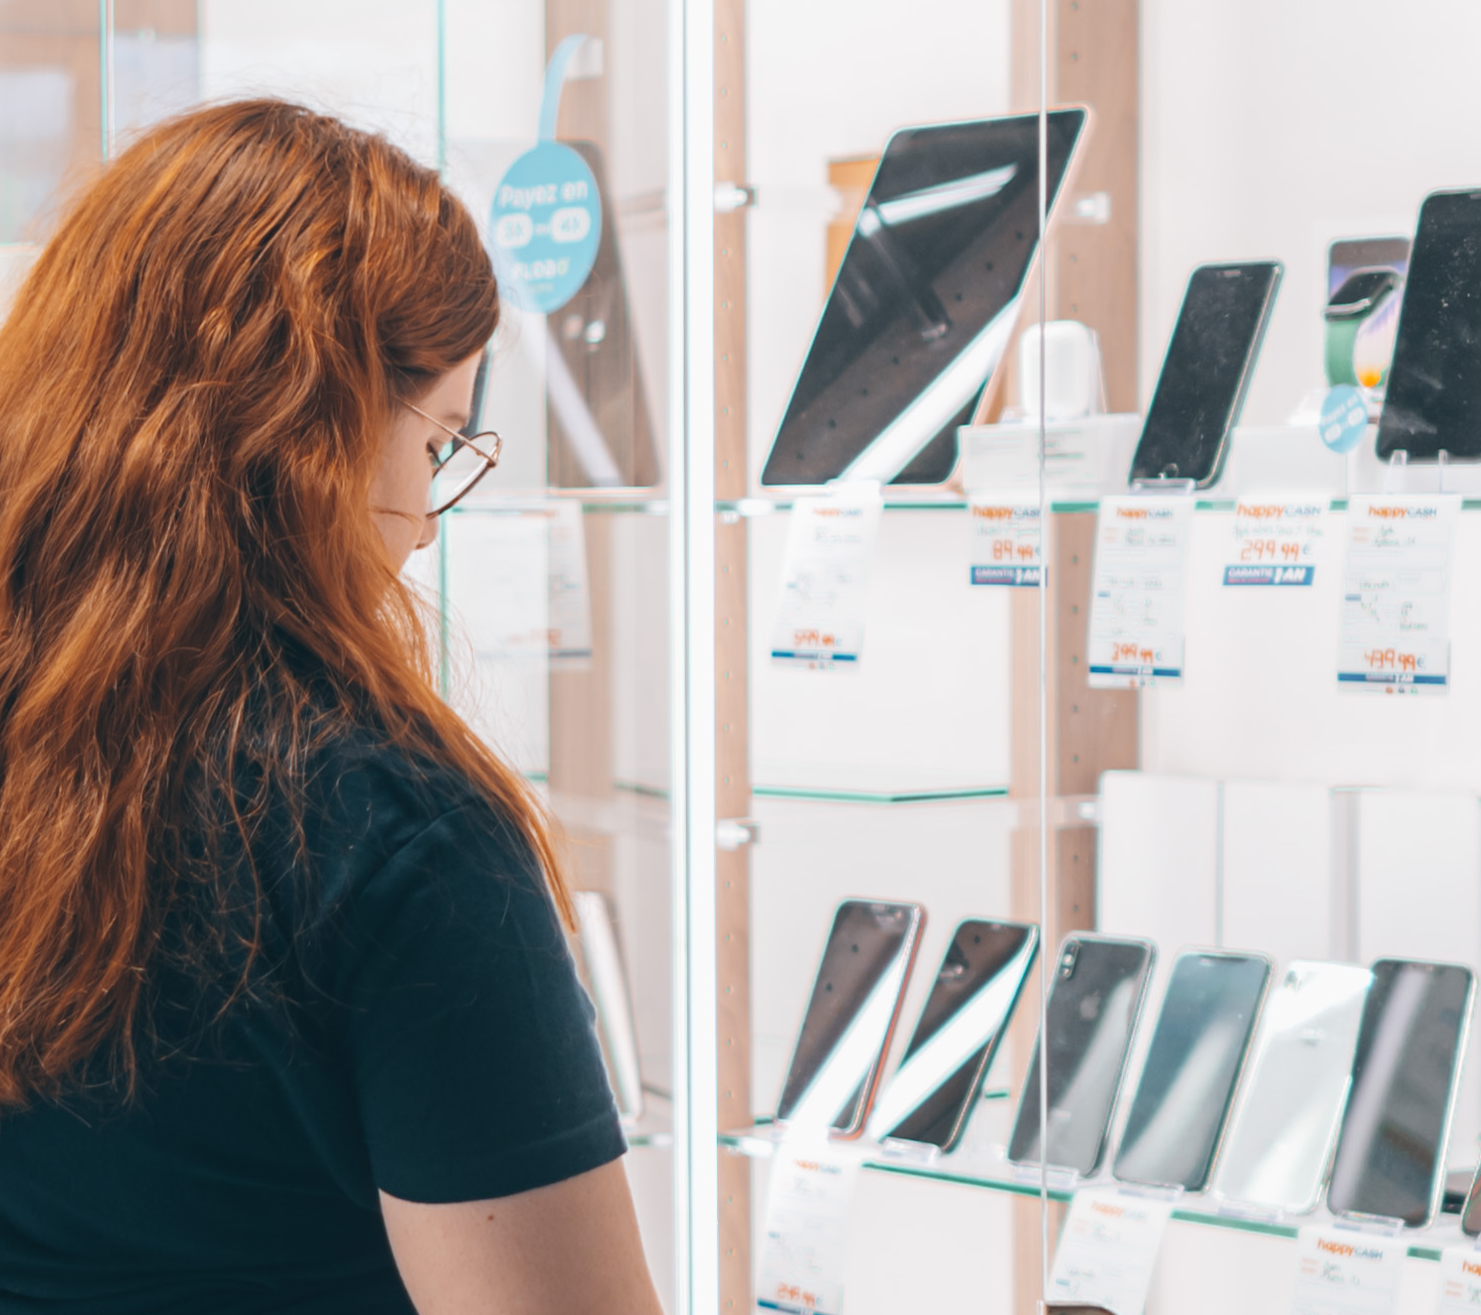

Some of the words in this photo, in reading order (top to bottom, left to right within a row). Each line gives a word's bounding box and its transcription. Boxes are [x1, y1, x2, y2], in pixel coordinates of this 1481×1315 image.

[499, 184, 557, 210] Payez
[562, 181, 587, 201] en
[1117, 507, 1173, 519] happyCASH
[1236, 503, 1322, 519] happyCASH
[1368, 506, 1437, 519] happyCASH
[1228, 567, 1274, 579] GARANTIE
[1317, 1238, 1383, 1261] happyCASH
